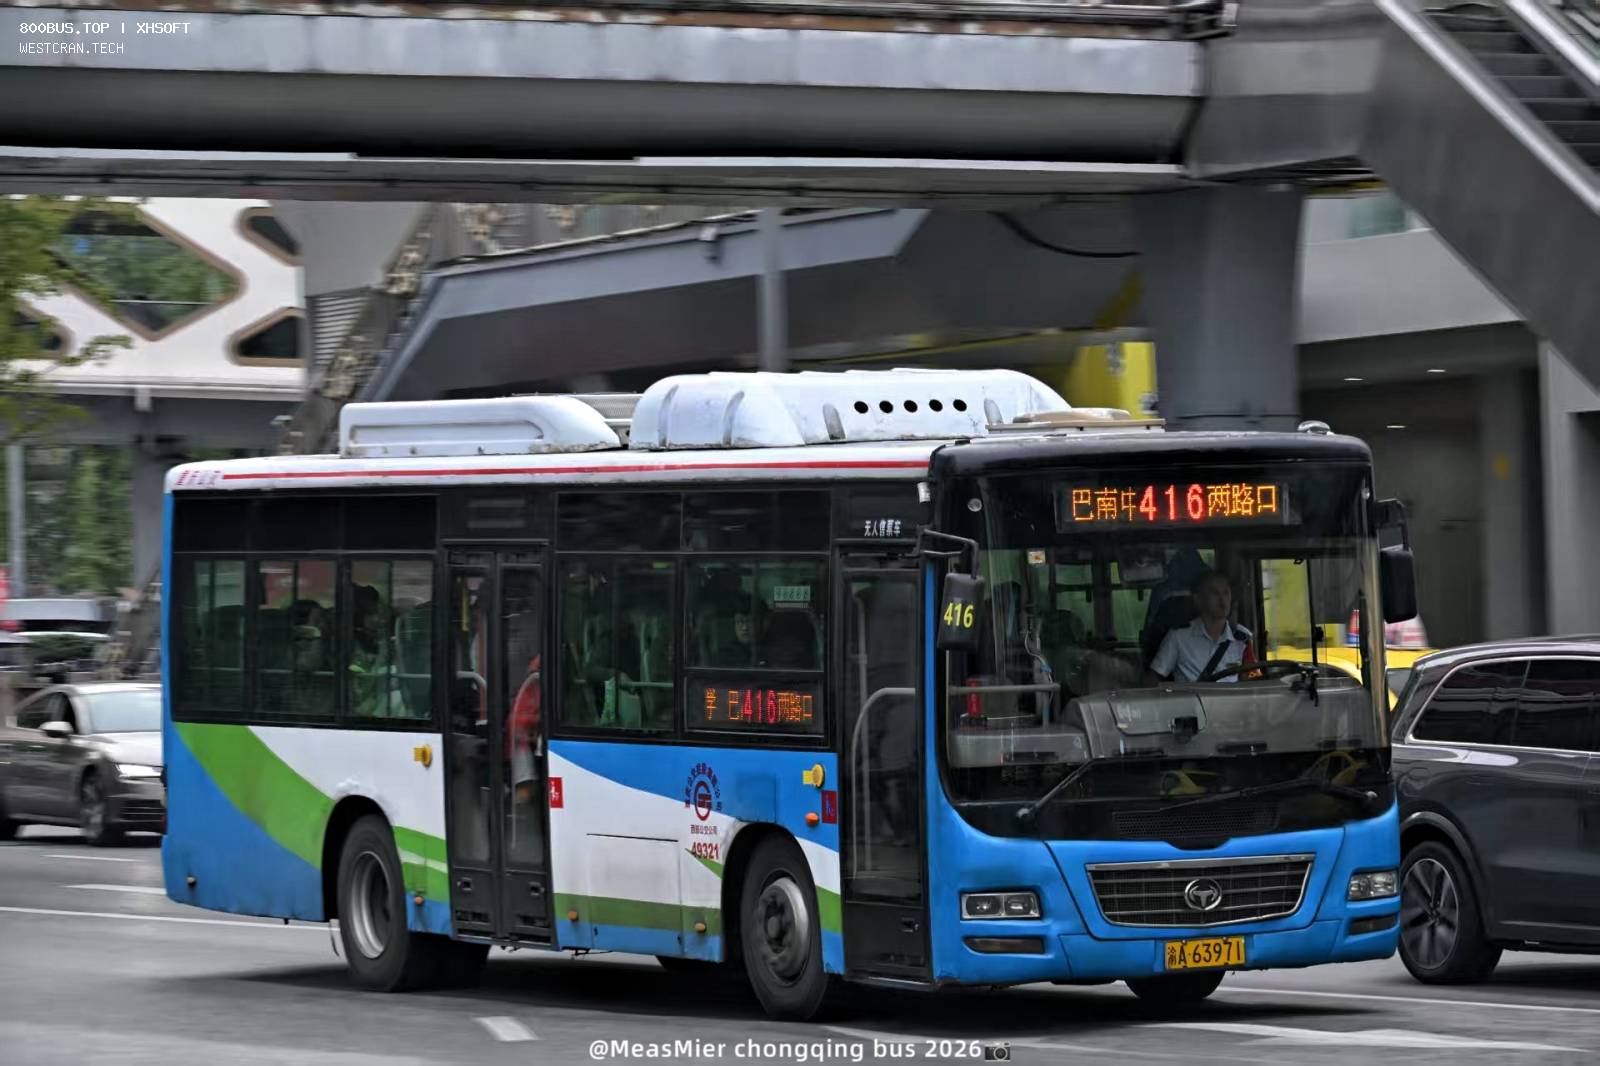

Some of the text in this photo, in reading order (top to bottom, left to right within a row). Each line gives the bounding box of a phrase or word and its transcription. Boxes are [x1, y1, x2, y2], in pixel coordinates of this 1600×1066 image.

[1139, 484, 1203, 521] 416
[1206, 483, 1277, 517] 两路口
[943, 602, 974, 628] 416
[743, 688, 776, 724] 416
[691, 841, 720, 860] 49321
